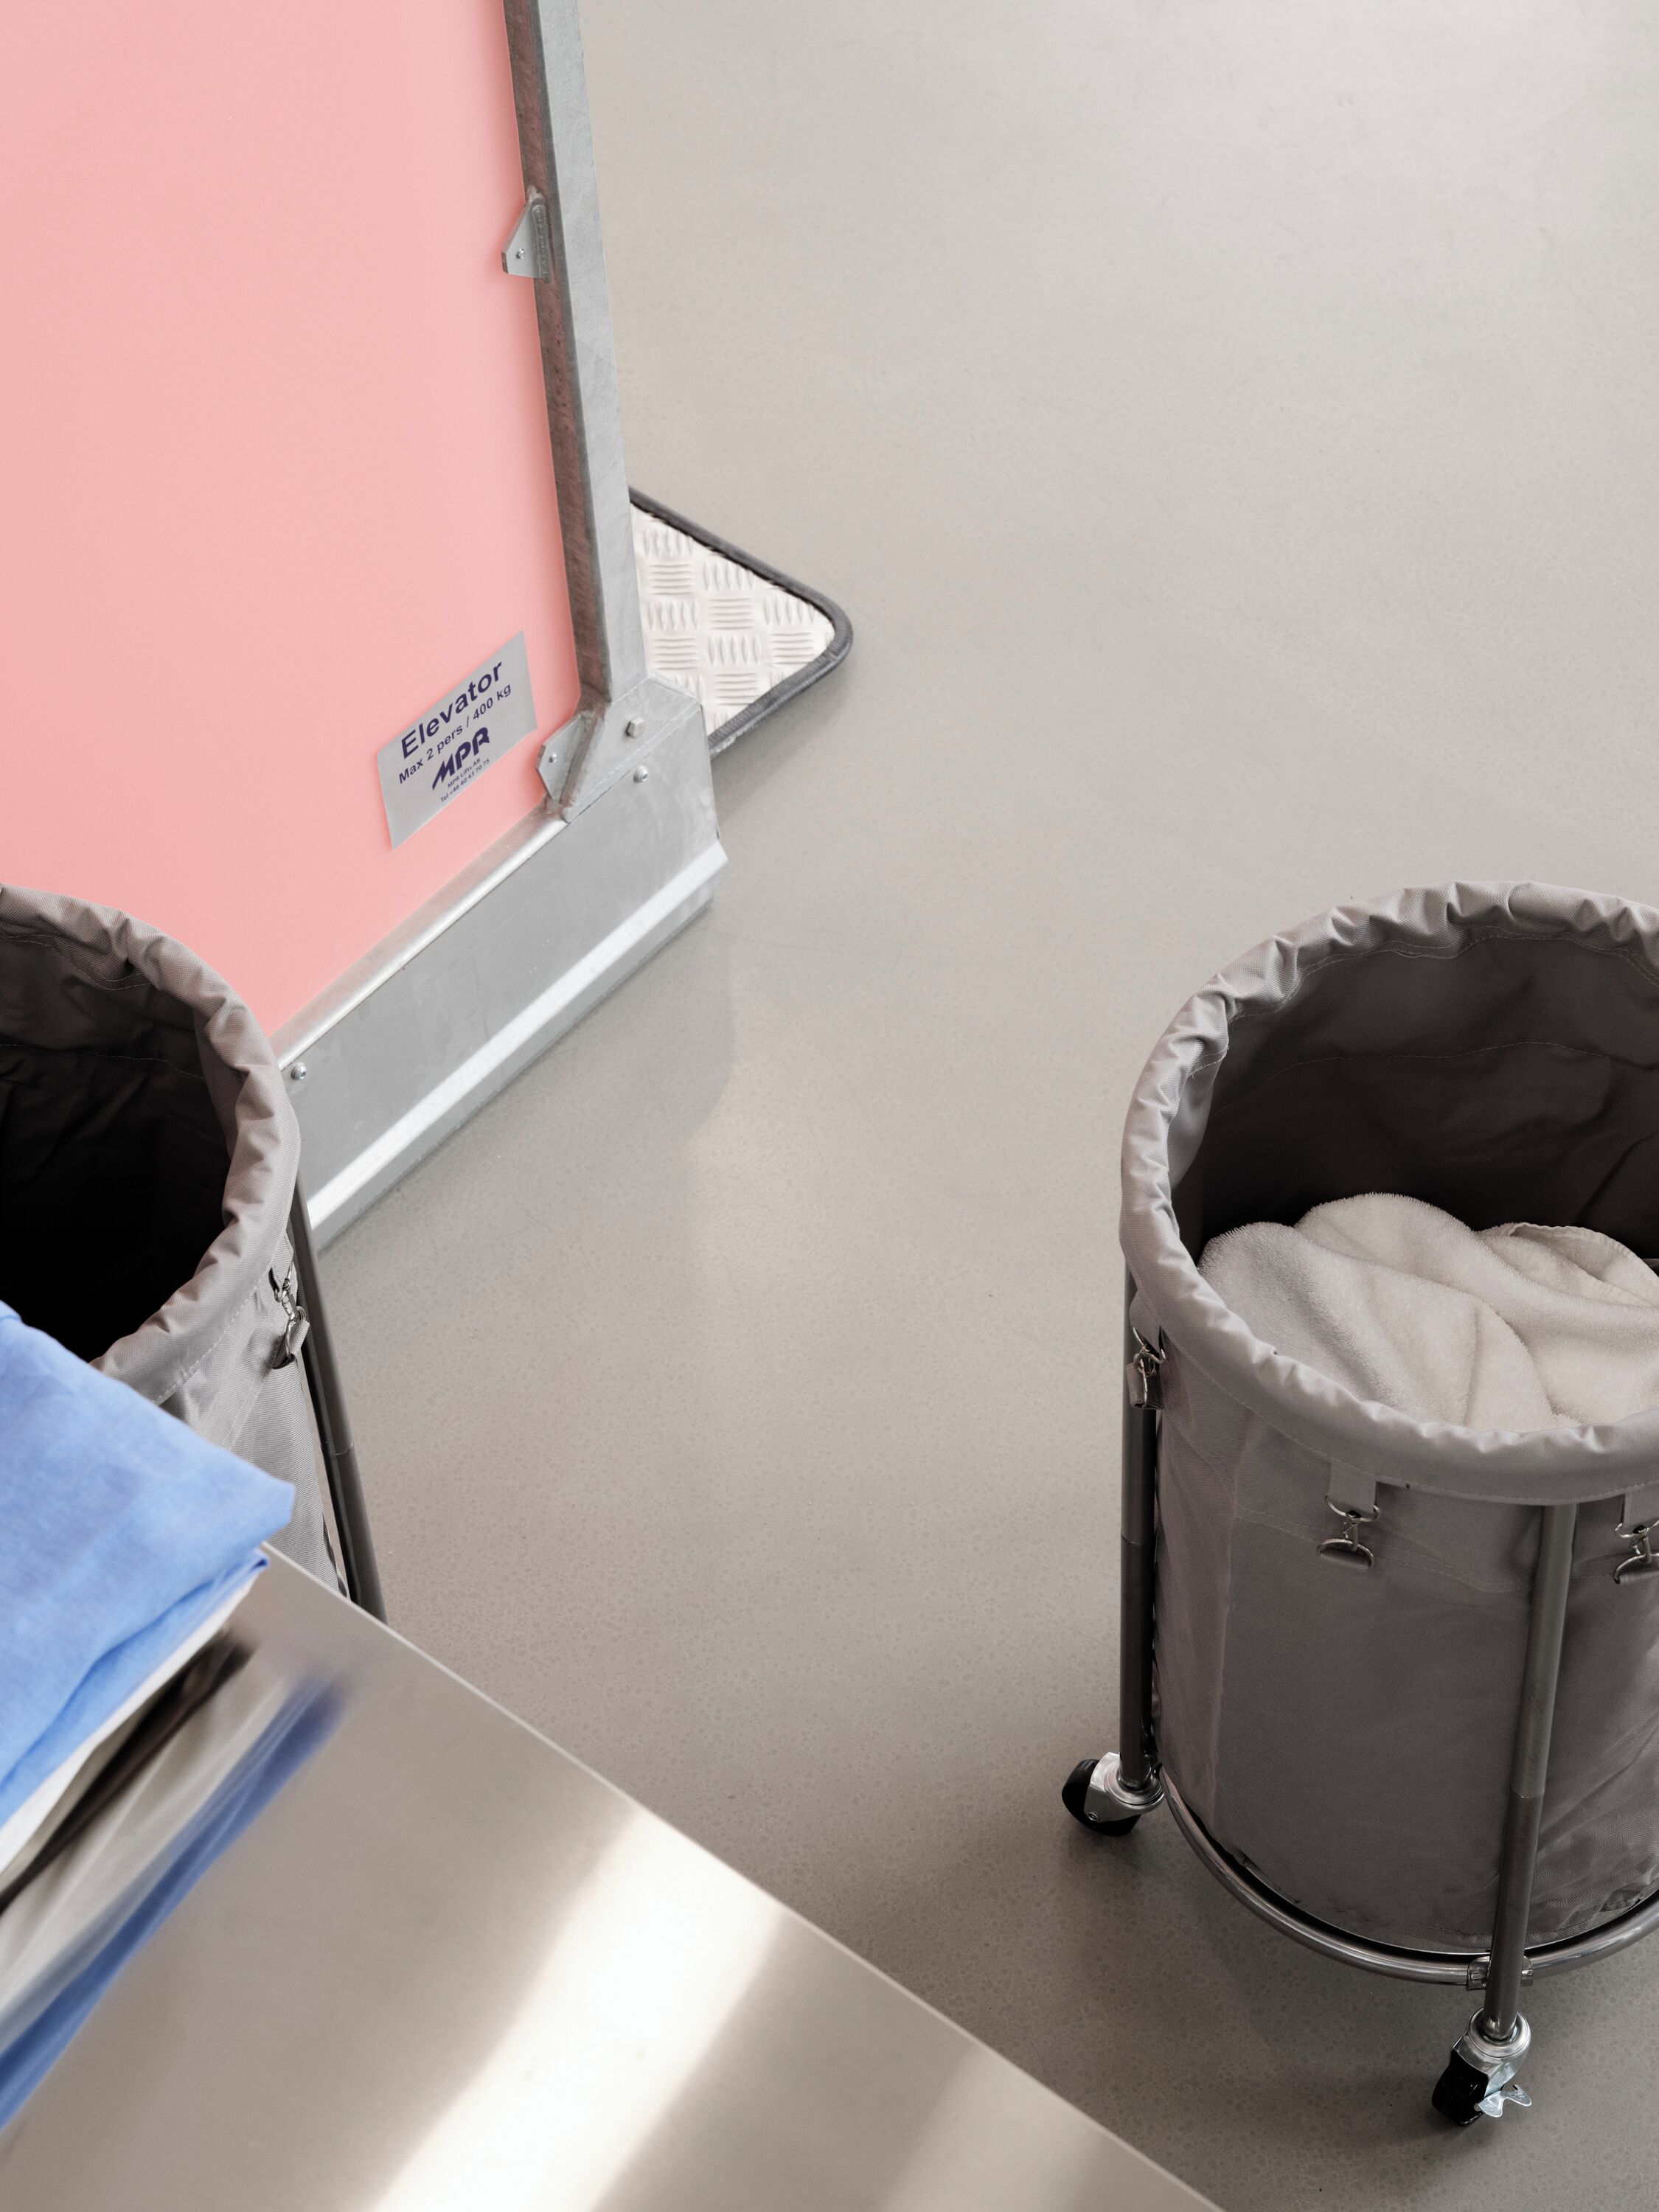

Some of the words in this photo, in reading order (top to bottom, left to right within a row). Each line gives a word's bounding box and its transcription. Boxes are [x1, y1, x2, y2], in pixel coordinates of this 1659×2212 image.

[399, 759, 424, 784] Max
[426, 748, 434, 761] 2
[437, 726, 463, 754] pers
[466, 716, 470, 728] /
[473, 698, 493, 720] 400
[496, 684, 511, 700] kg
[401, 662, 502, 759] Elevator
[432, 727, 490, 790] MPR
[448, 776, 460, 788] MPR
[460, 766, 473, 778] Lifts
[440, 793, 449, 802] Tel
